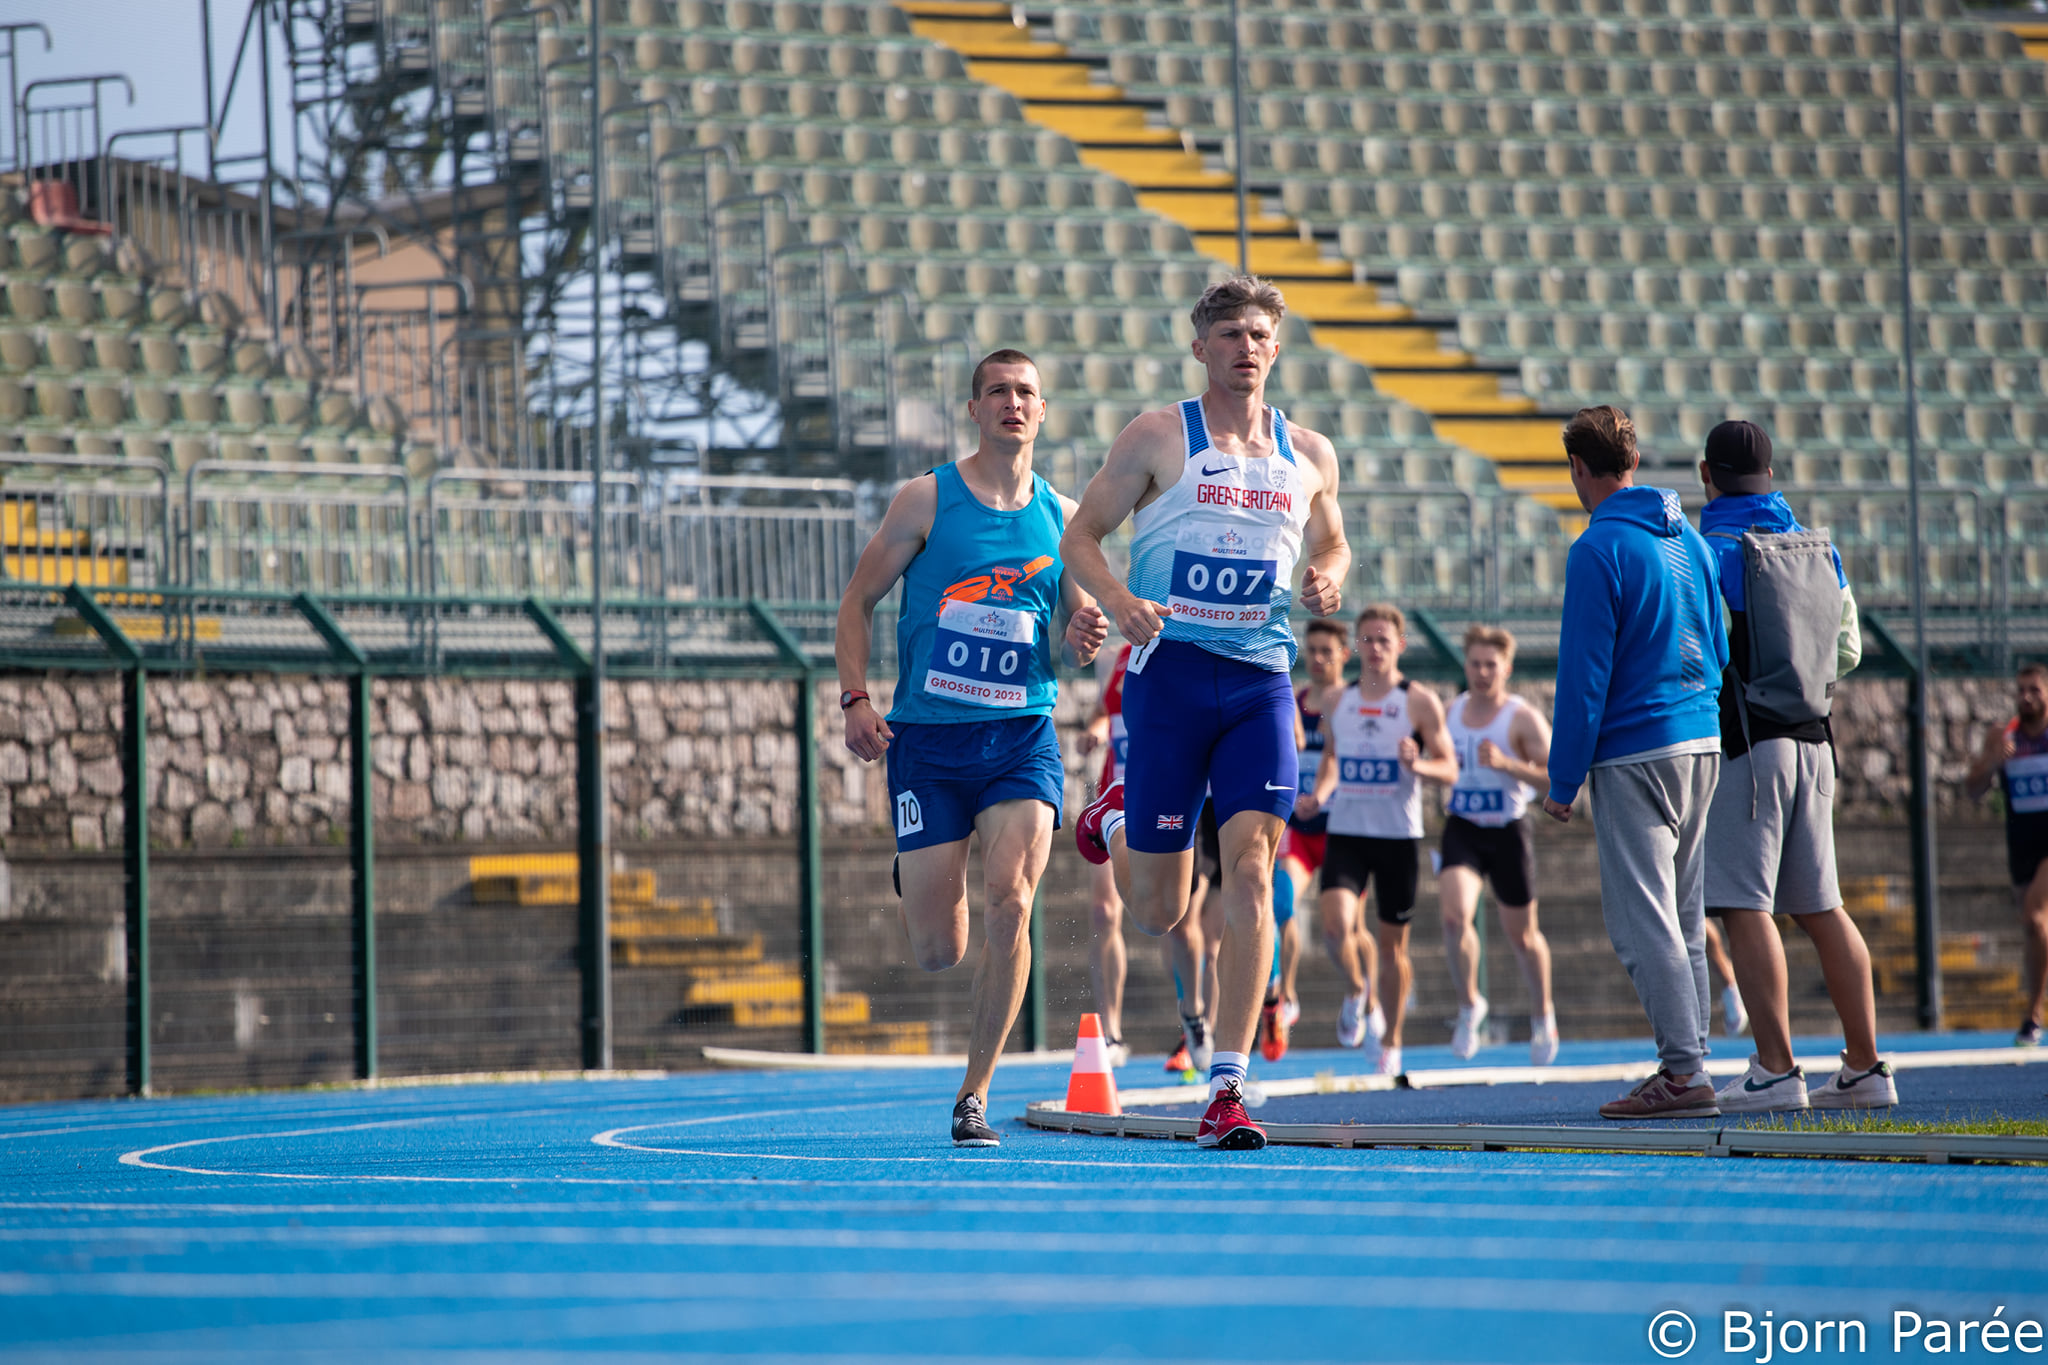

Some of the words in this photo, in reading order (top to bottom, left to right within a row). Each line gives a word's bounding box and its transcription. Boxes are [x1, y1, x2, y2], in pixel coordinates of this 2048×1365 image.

[1197, 484, 1241, 508] GREAT
[1242, 489, 1292, 513] BRITAIN
[1212, 547, 1247, 556] MULTISTARS
[1187, 563, 1267, 596] 007
[1172, 603, 1235, 621] GROSSETO
[1239, 610, 1267, 621] 2022
[973, 626, 1008, 638] MULTISTARS
[947, 641, 1019, 676] 010
[930, 677, 991, 698] GROSSETO
[994, 689, 1022, 701] 2022
[1343, 760, 1391, 781] 002
[900, 797, 919, 829] 10
